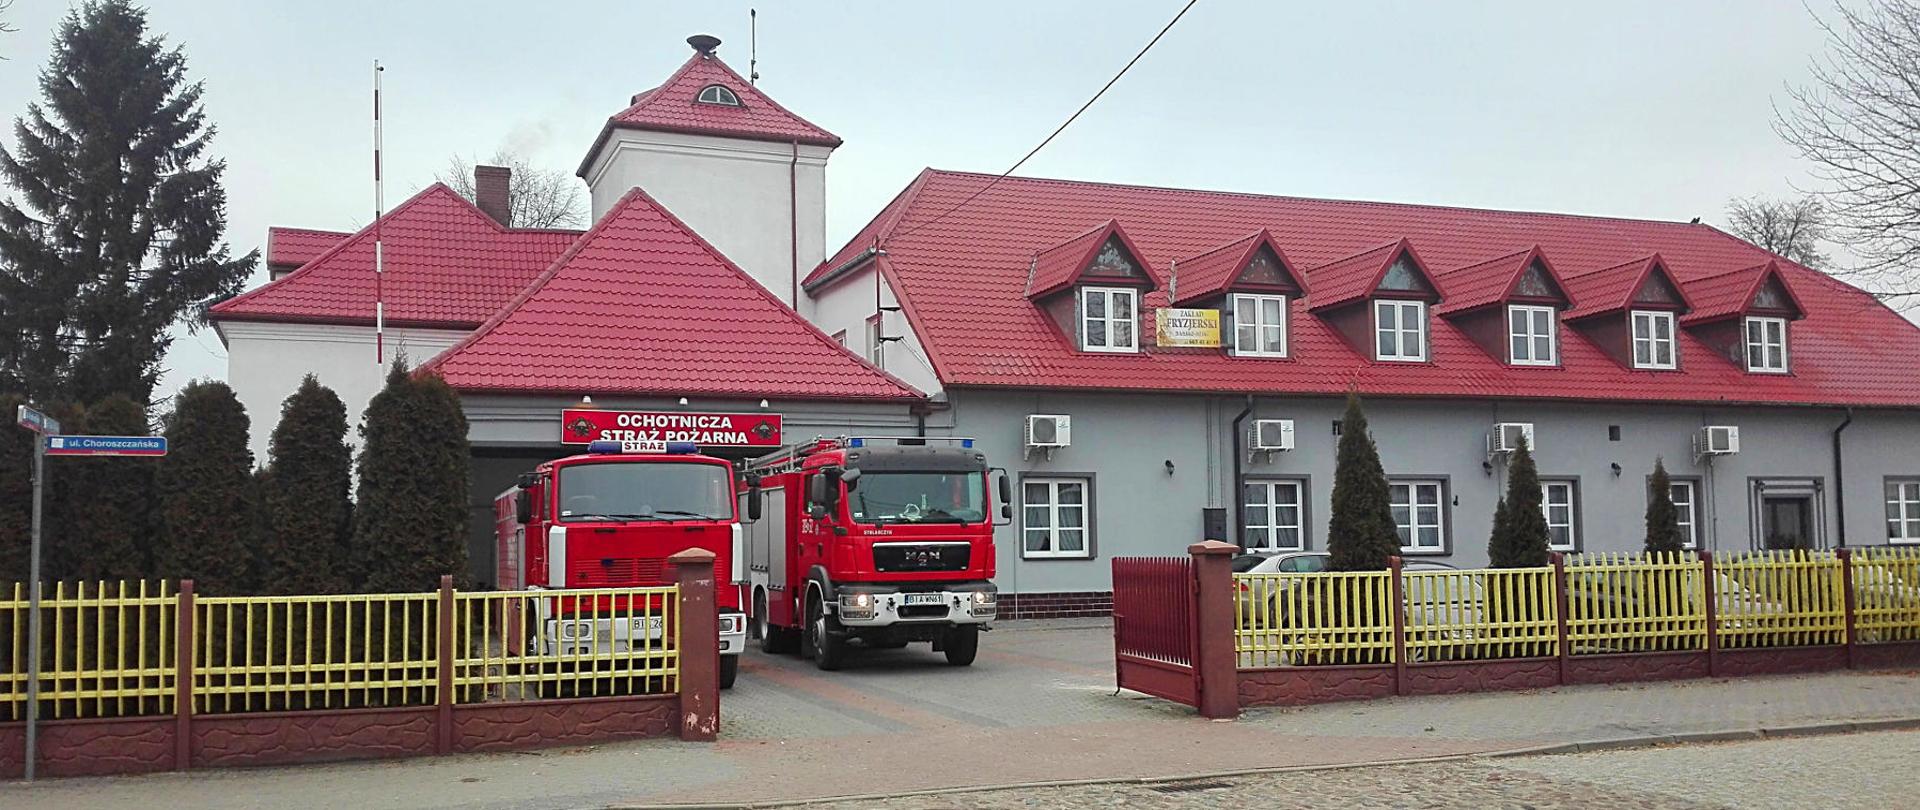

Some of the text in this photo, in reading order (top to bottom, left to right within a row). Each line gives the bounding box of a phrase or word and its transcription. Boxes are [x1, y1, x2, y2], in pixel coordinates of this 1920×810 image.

[1167, 318, 1217, 330] FRYZJERSKI
[617, 414, 733, 429] OCHOTNICZA
[600, 427, 749, 444] STRAŻ POŻARNA
[69, 439, 159, 448] ul. Choroszczańska
[905, 551, 940, 560] MAN
